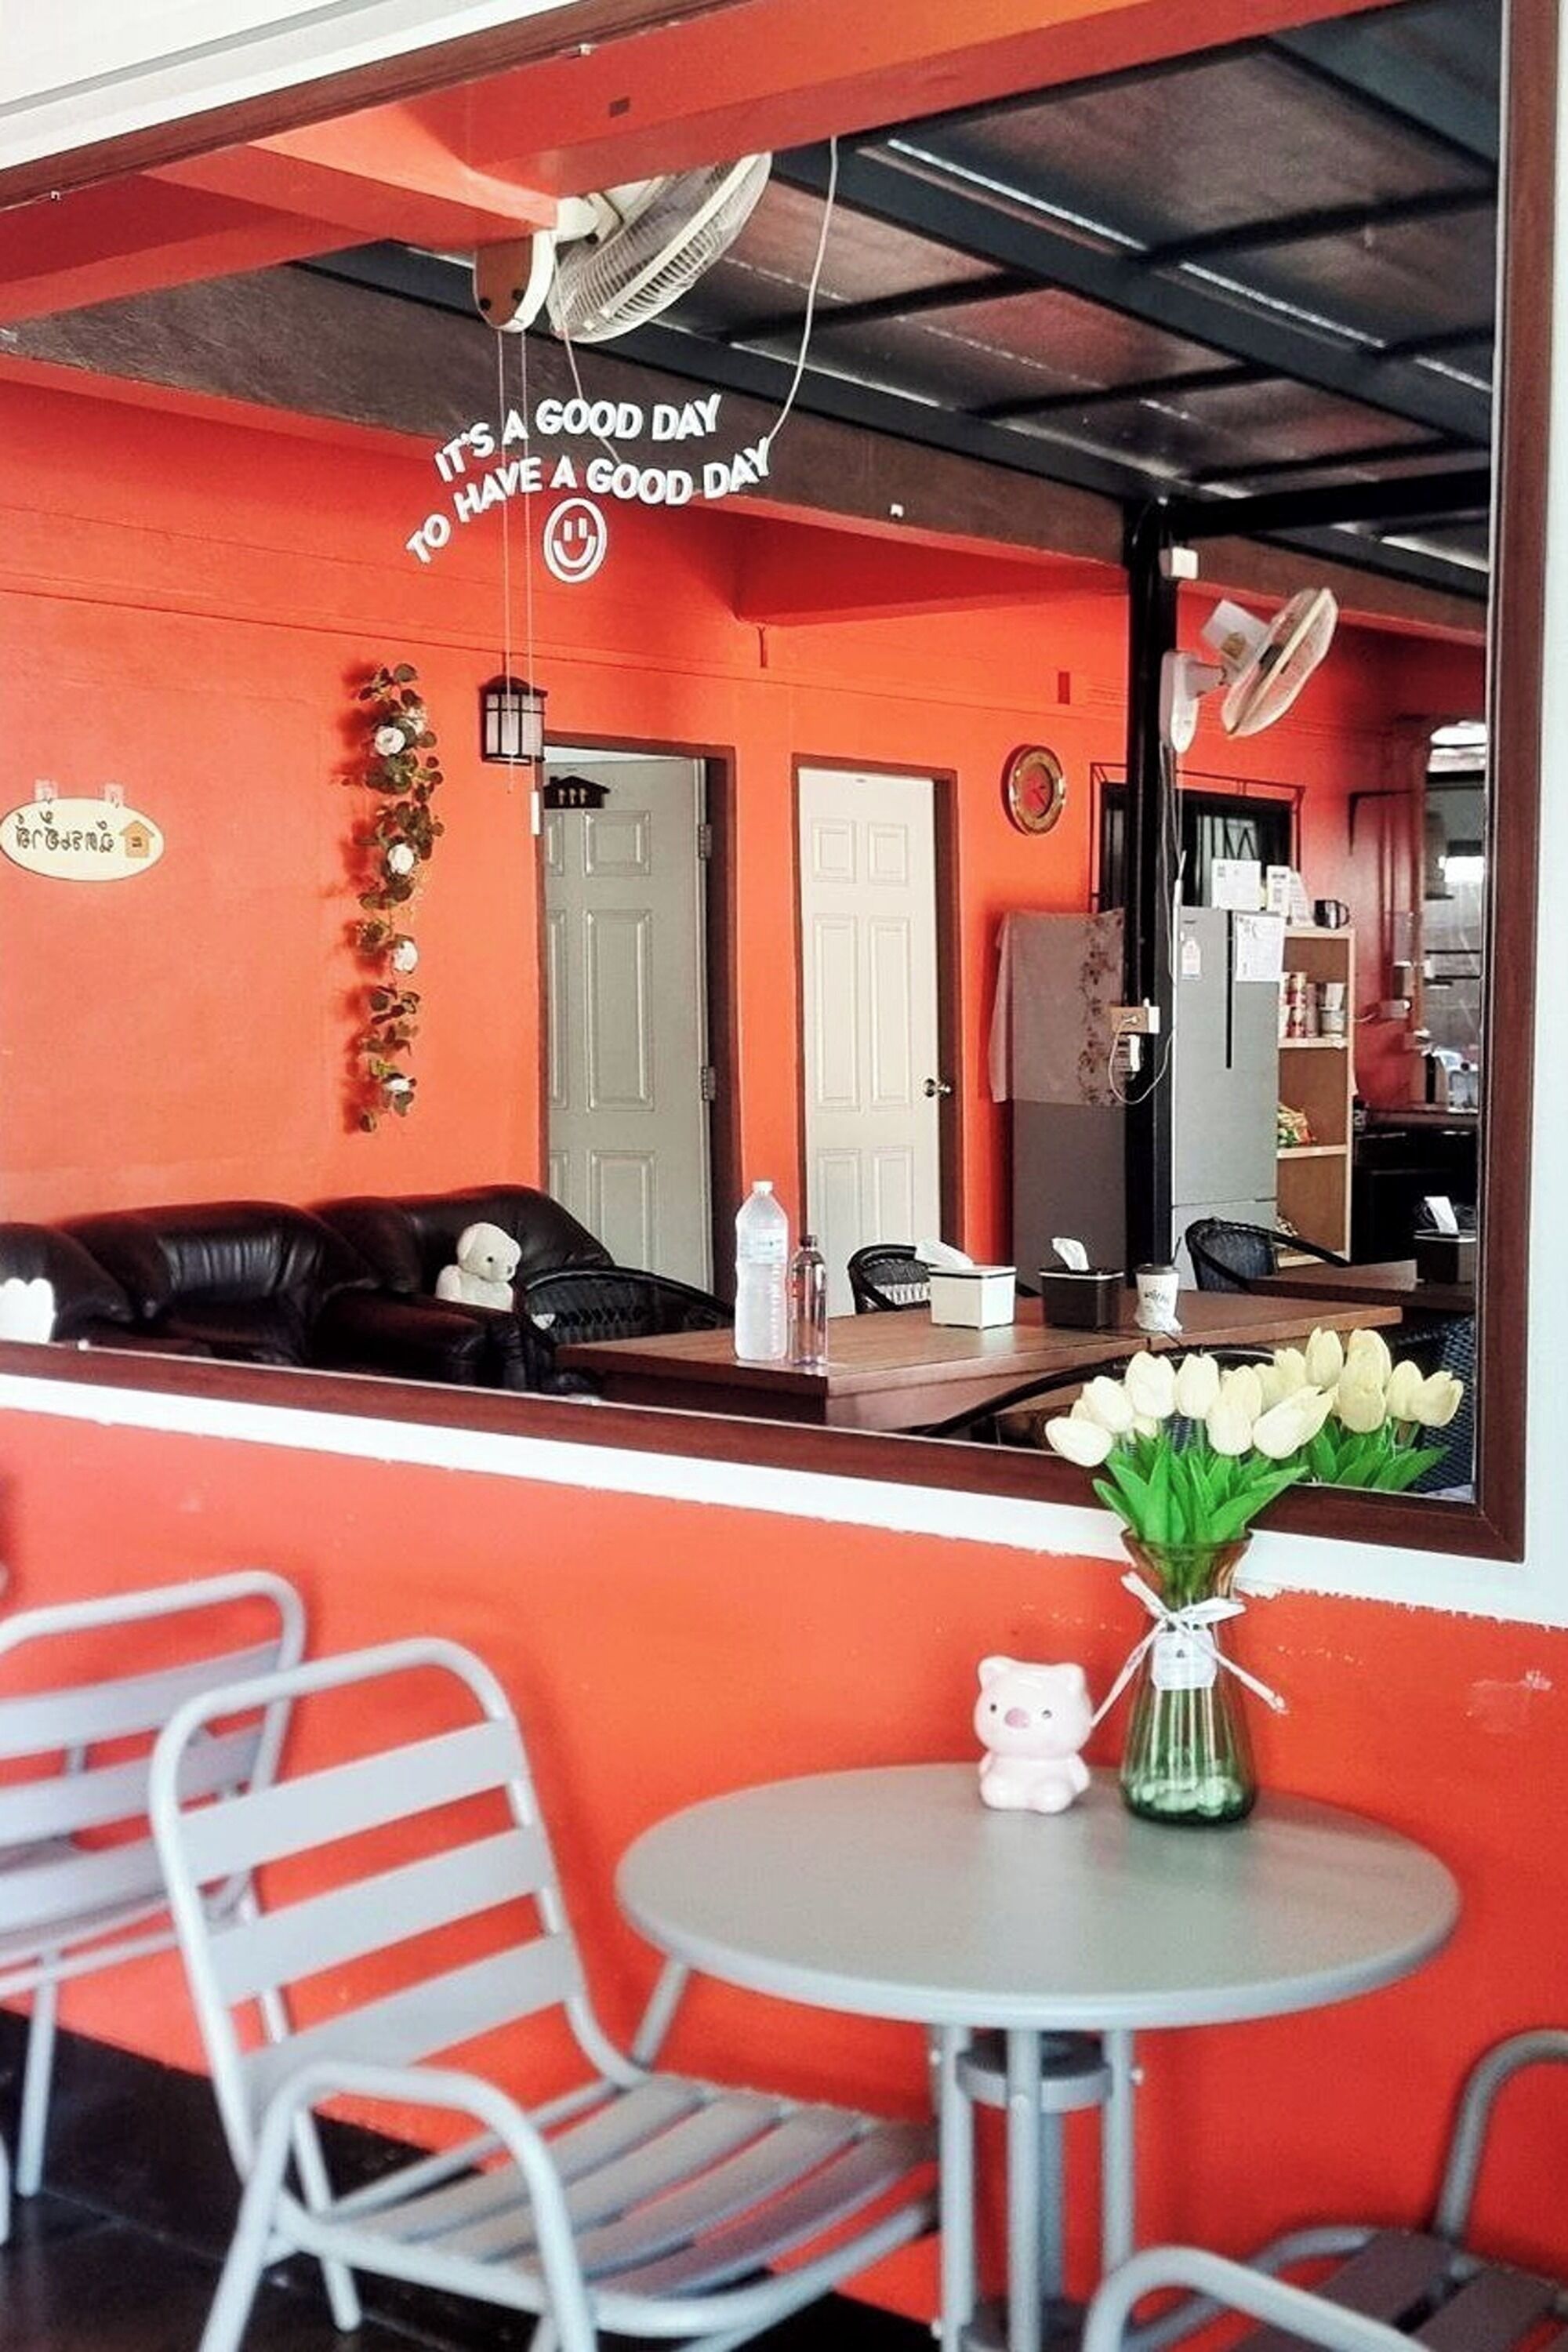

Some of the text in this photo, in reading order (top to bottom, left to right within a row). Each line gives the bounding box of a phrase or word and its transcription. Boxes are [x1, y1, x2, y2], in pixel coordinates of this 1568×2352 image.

[434, 394, 721, 482] IT'S A GOOD DAY
[405, 437, 770, 564] TO HAVE A GOOD DAY
